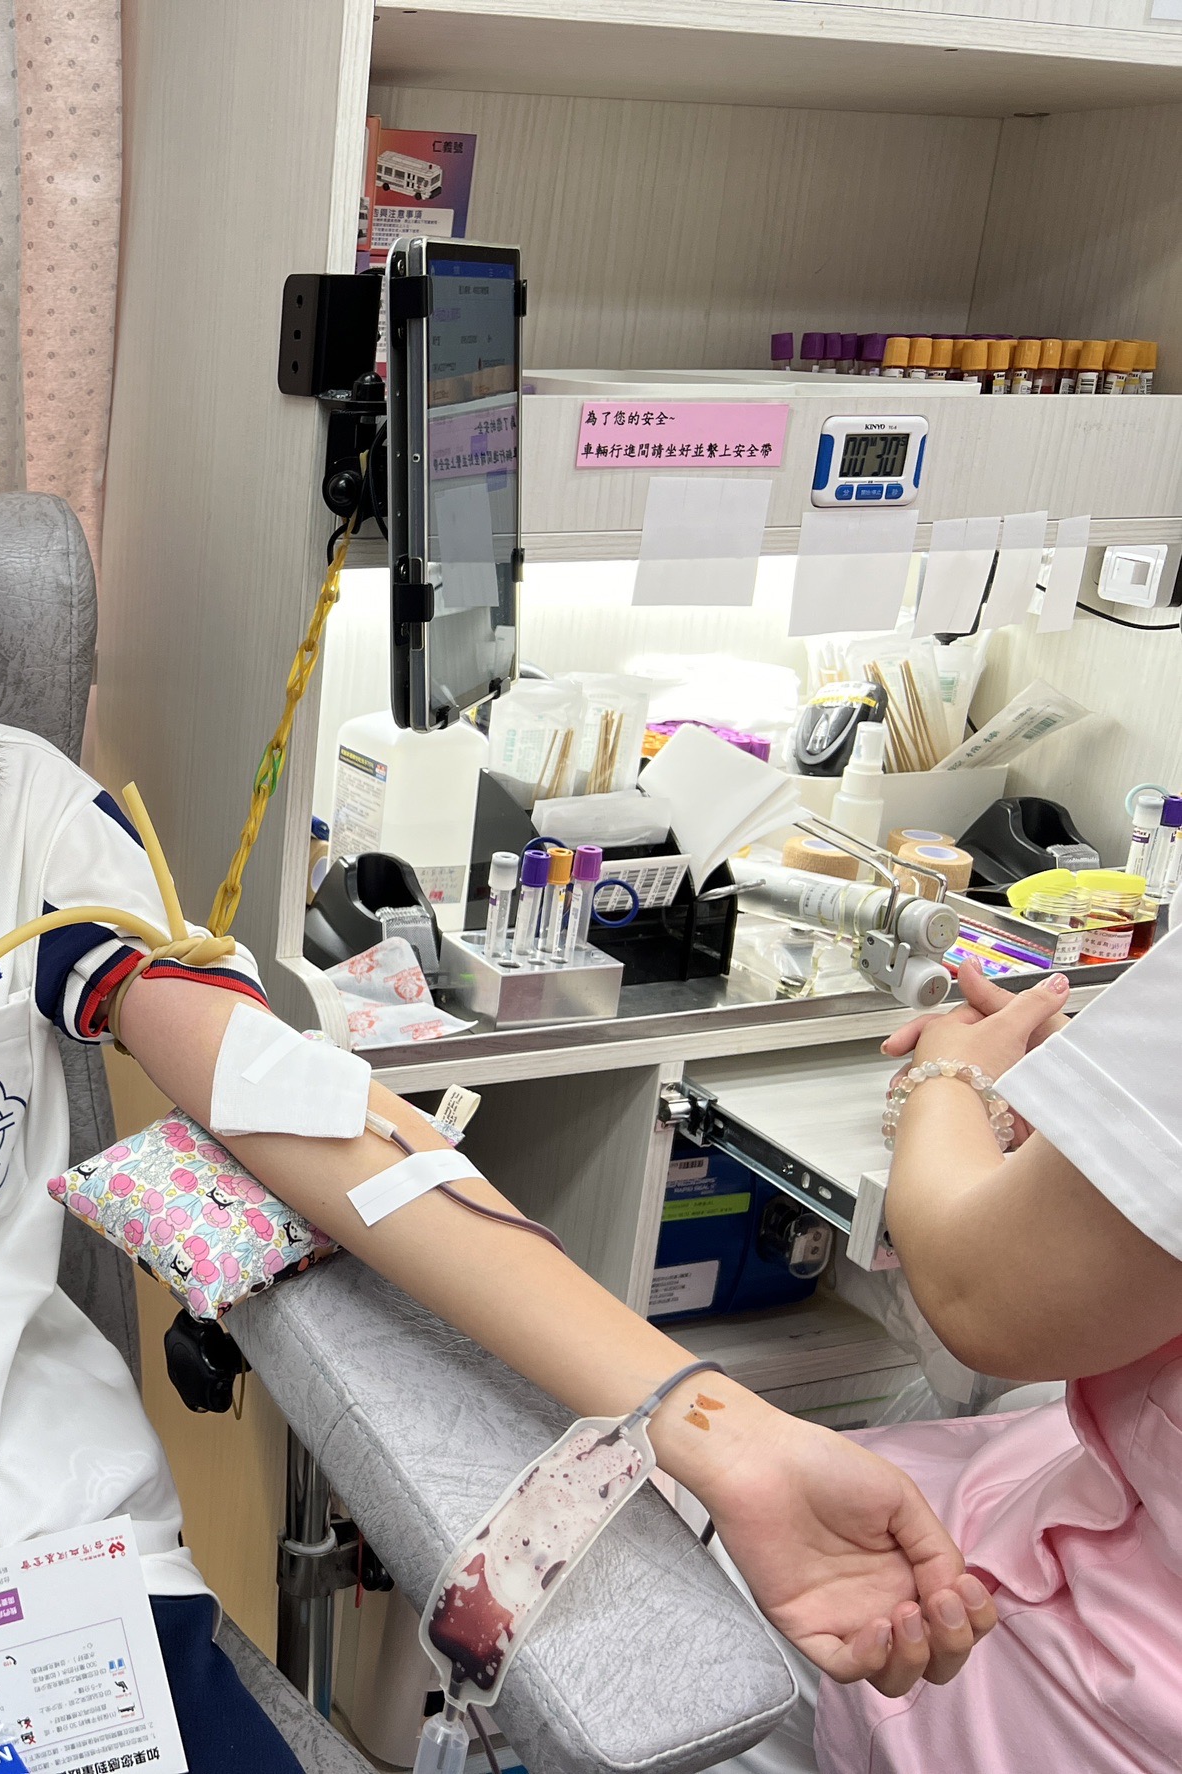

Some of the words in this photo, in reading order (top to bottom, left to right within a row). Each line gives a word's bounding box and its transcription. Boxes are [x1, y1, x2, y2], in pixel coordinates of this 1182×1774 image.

[432, 140, 464, 154] 仁義號
[864, 423, 885, 431] KINYO
[580, 442, 773, 460] 車輛行進間請坐好並繫上安全帶
[53, 1745, 160, 1774] 如果您感到暈
